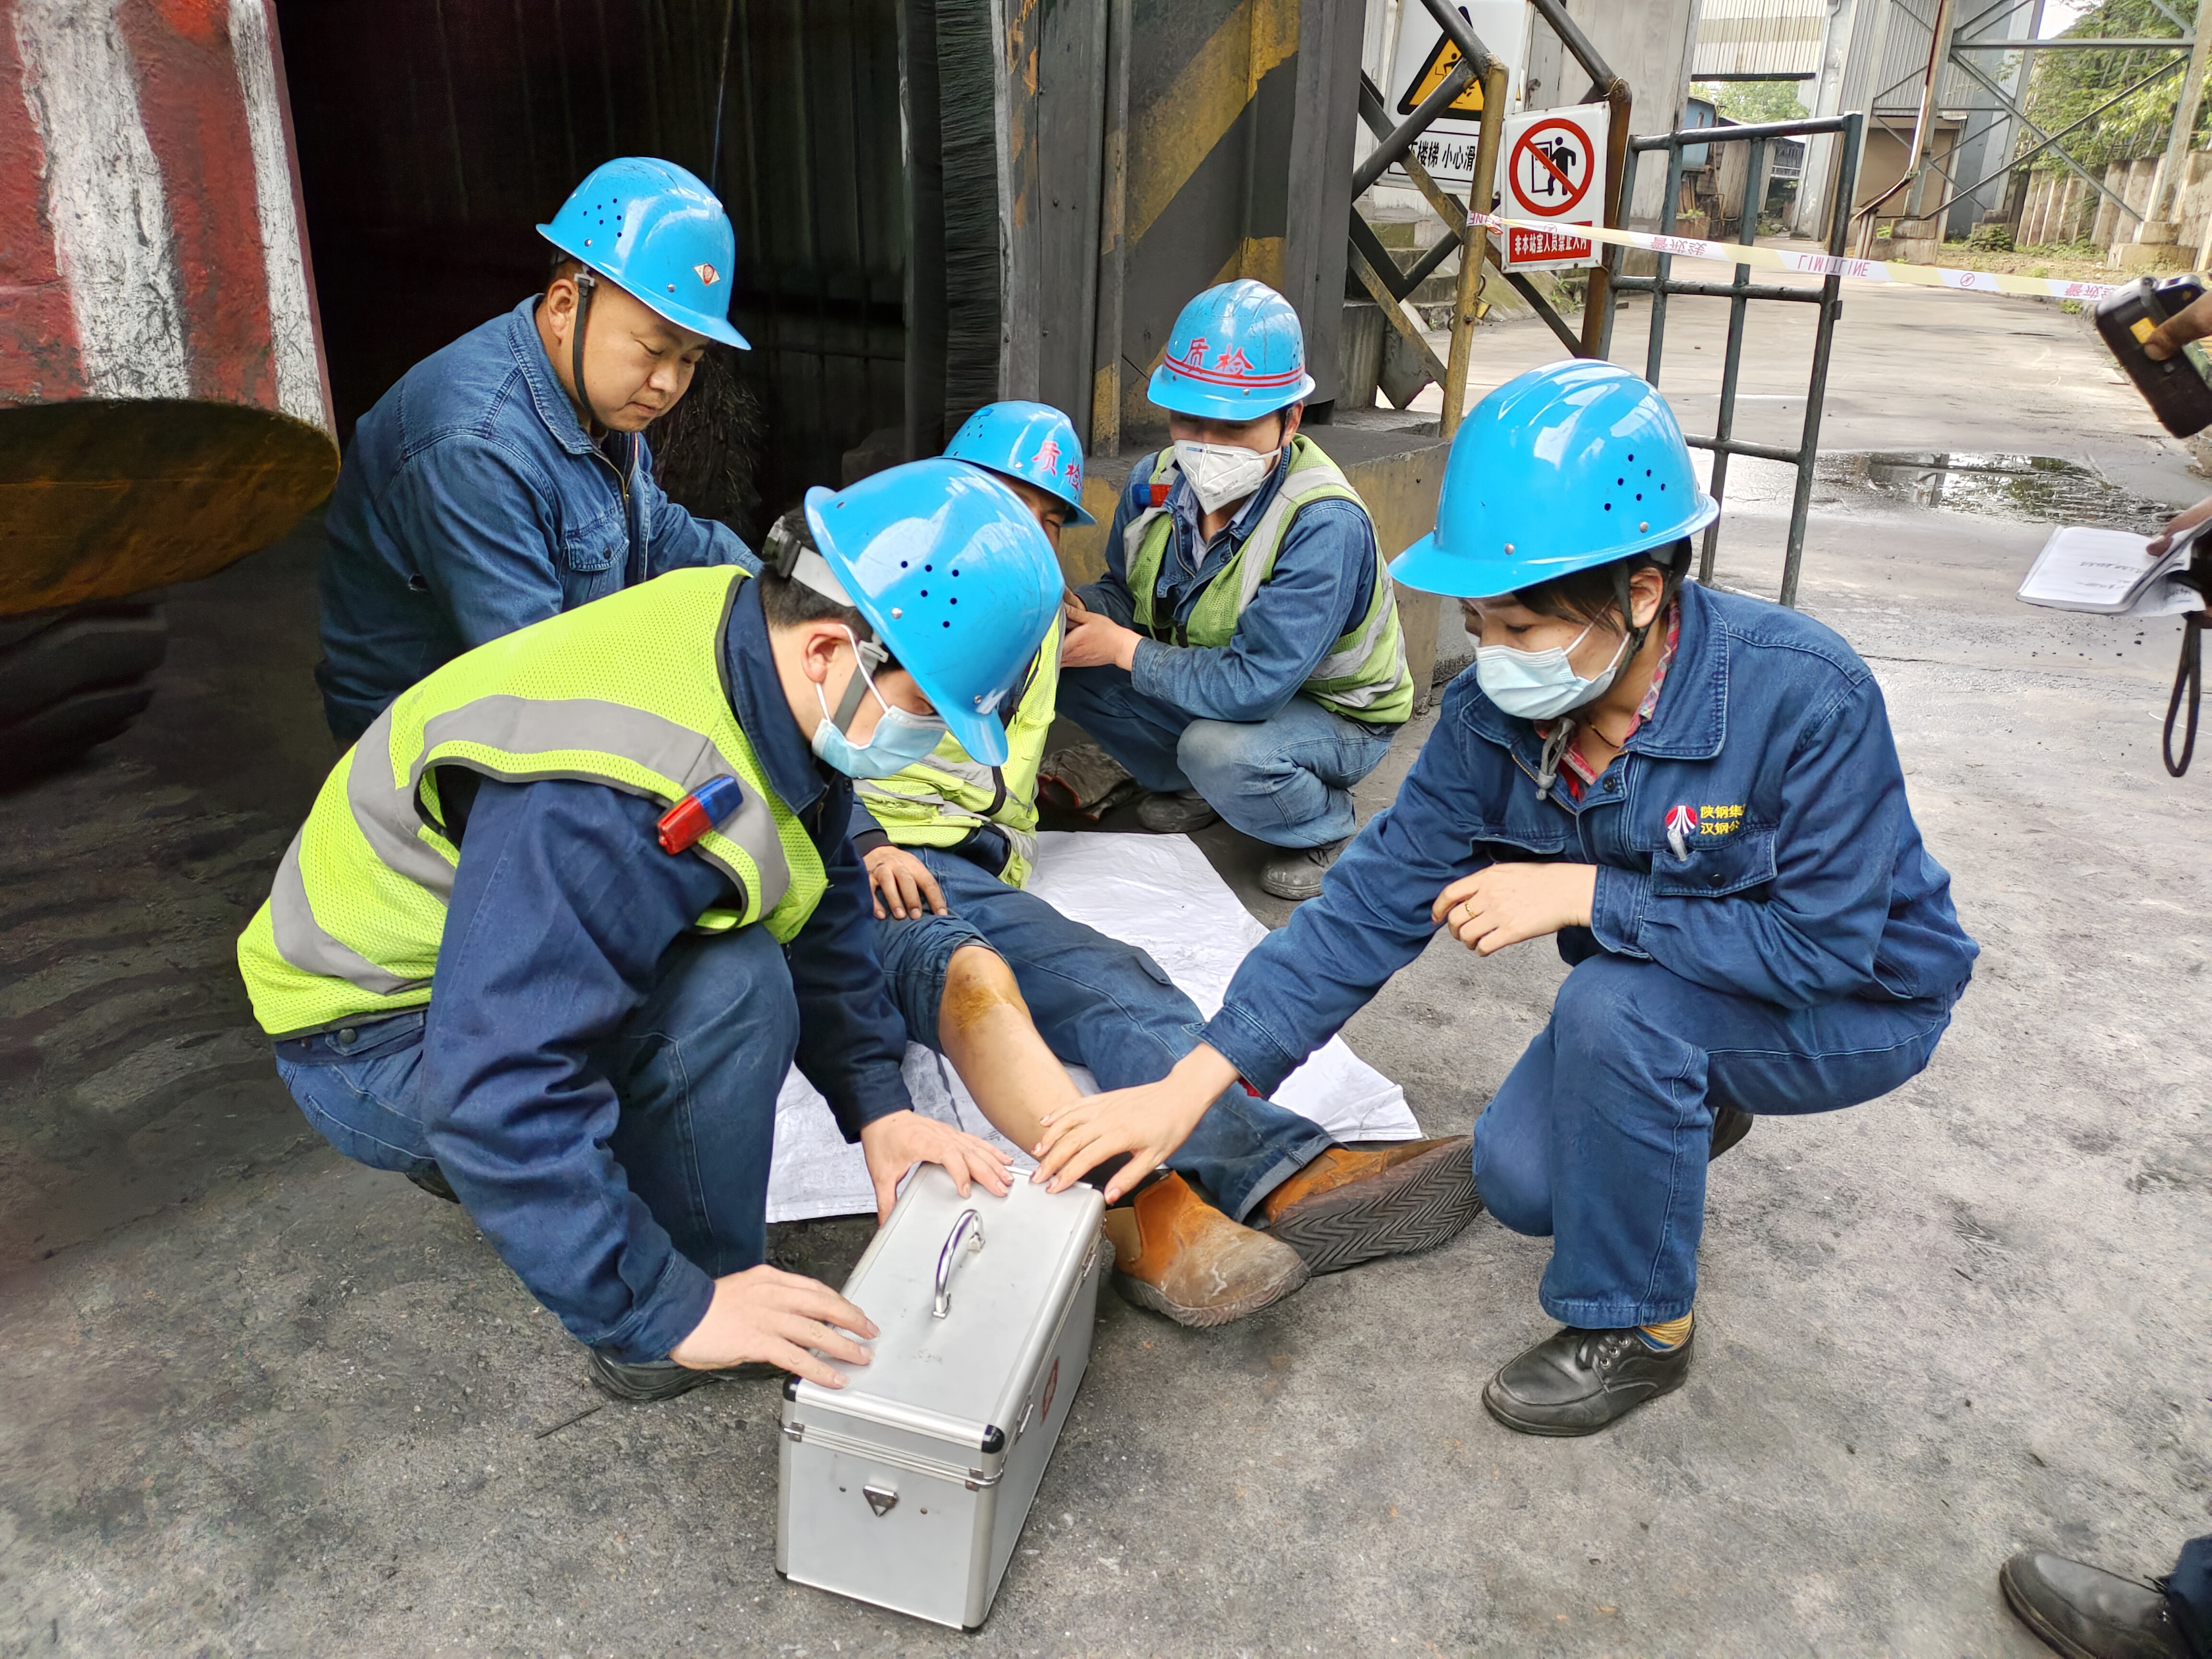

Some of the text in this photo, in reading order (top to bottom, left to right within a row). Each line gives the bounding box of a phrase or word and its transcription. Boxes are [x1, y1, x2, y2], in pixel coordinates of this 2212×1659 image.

[1442, 143, 1476, 171] 小心滑
[1182, 337, 1254, 377] 质检
[1031, 441, 1082, 492] 质检
[1700, 804, 1747, 819] 陕钢集
